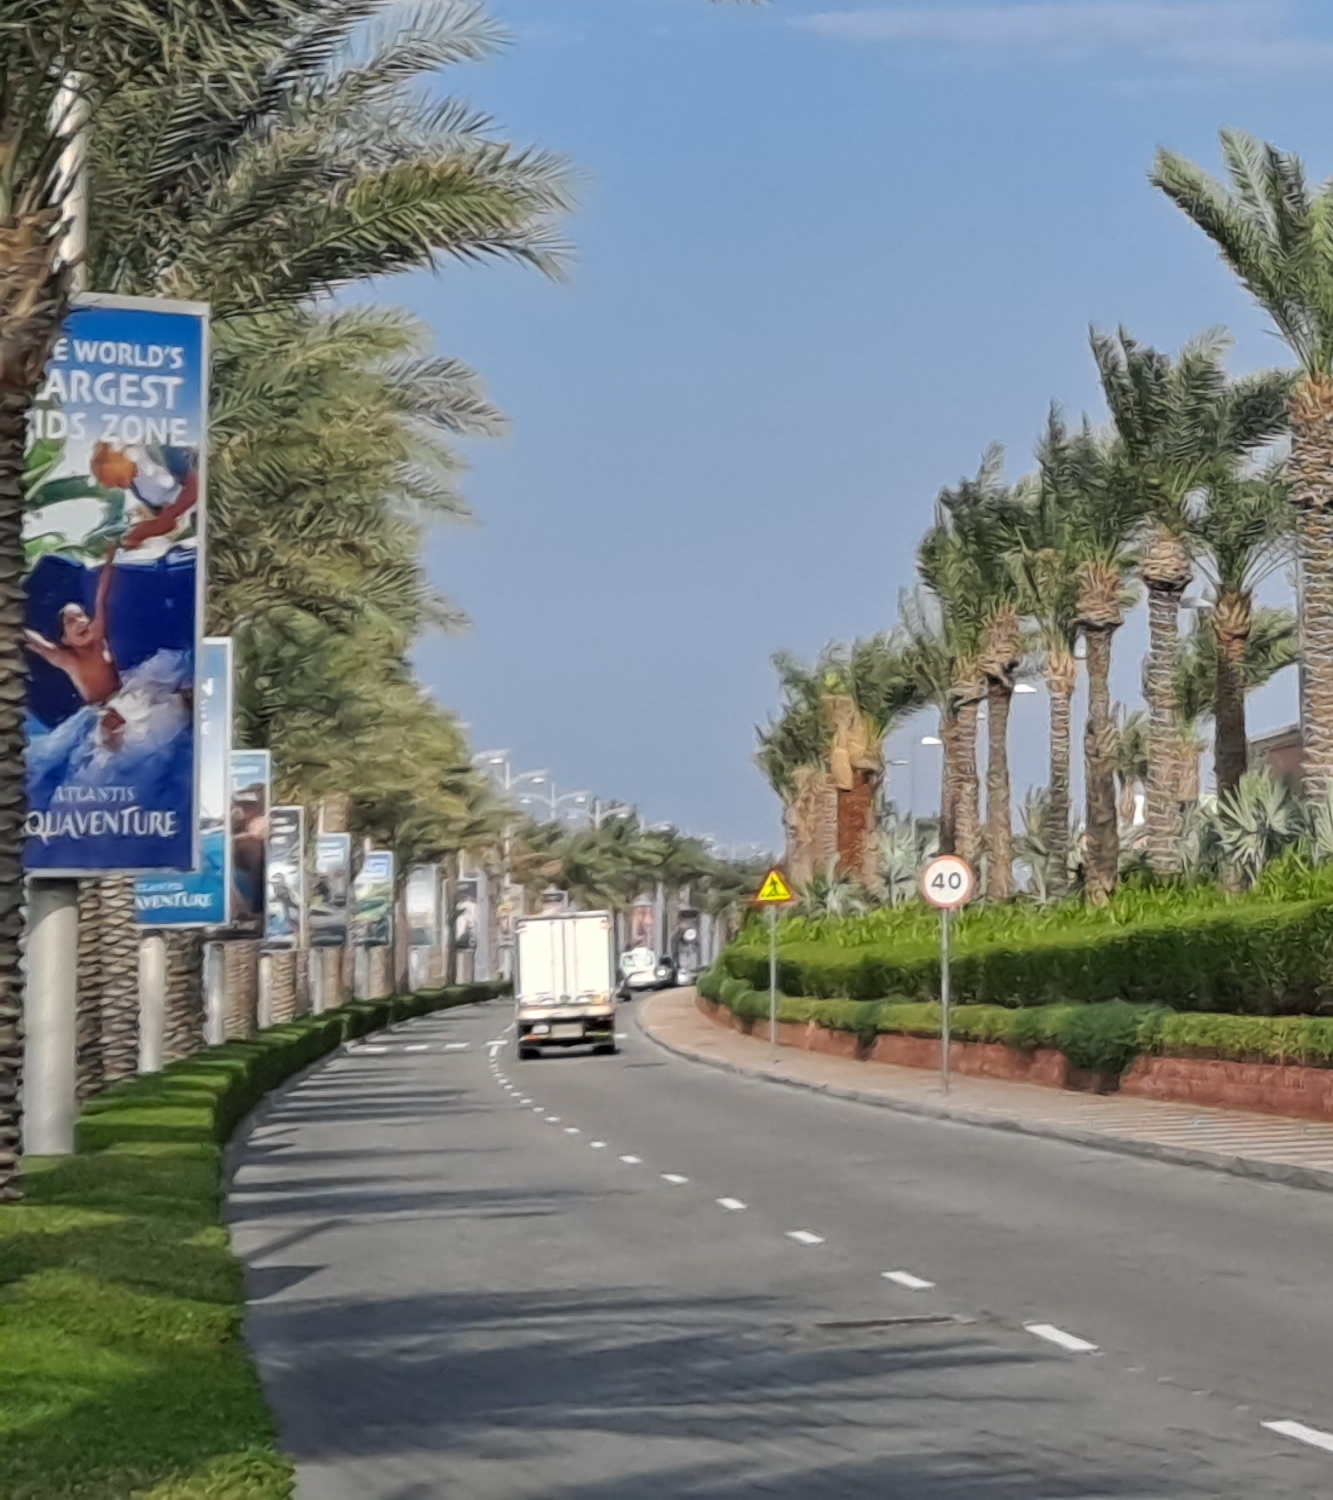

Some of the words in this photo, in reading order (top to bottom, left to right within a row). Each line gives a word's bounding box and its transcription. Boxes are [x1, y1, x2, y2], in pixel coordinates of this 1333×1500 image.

[72, 338, 184, 370] WORLD'S
[36, 368, 184, 411] ARGEST
[101, 413, 192, 447] ZONE
[53, 786, 137, 803] ATLANTIS
[22, 806, 179, 845] QUAVENTURE
[931, 872, 962, 890] 40
